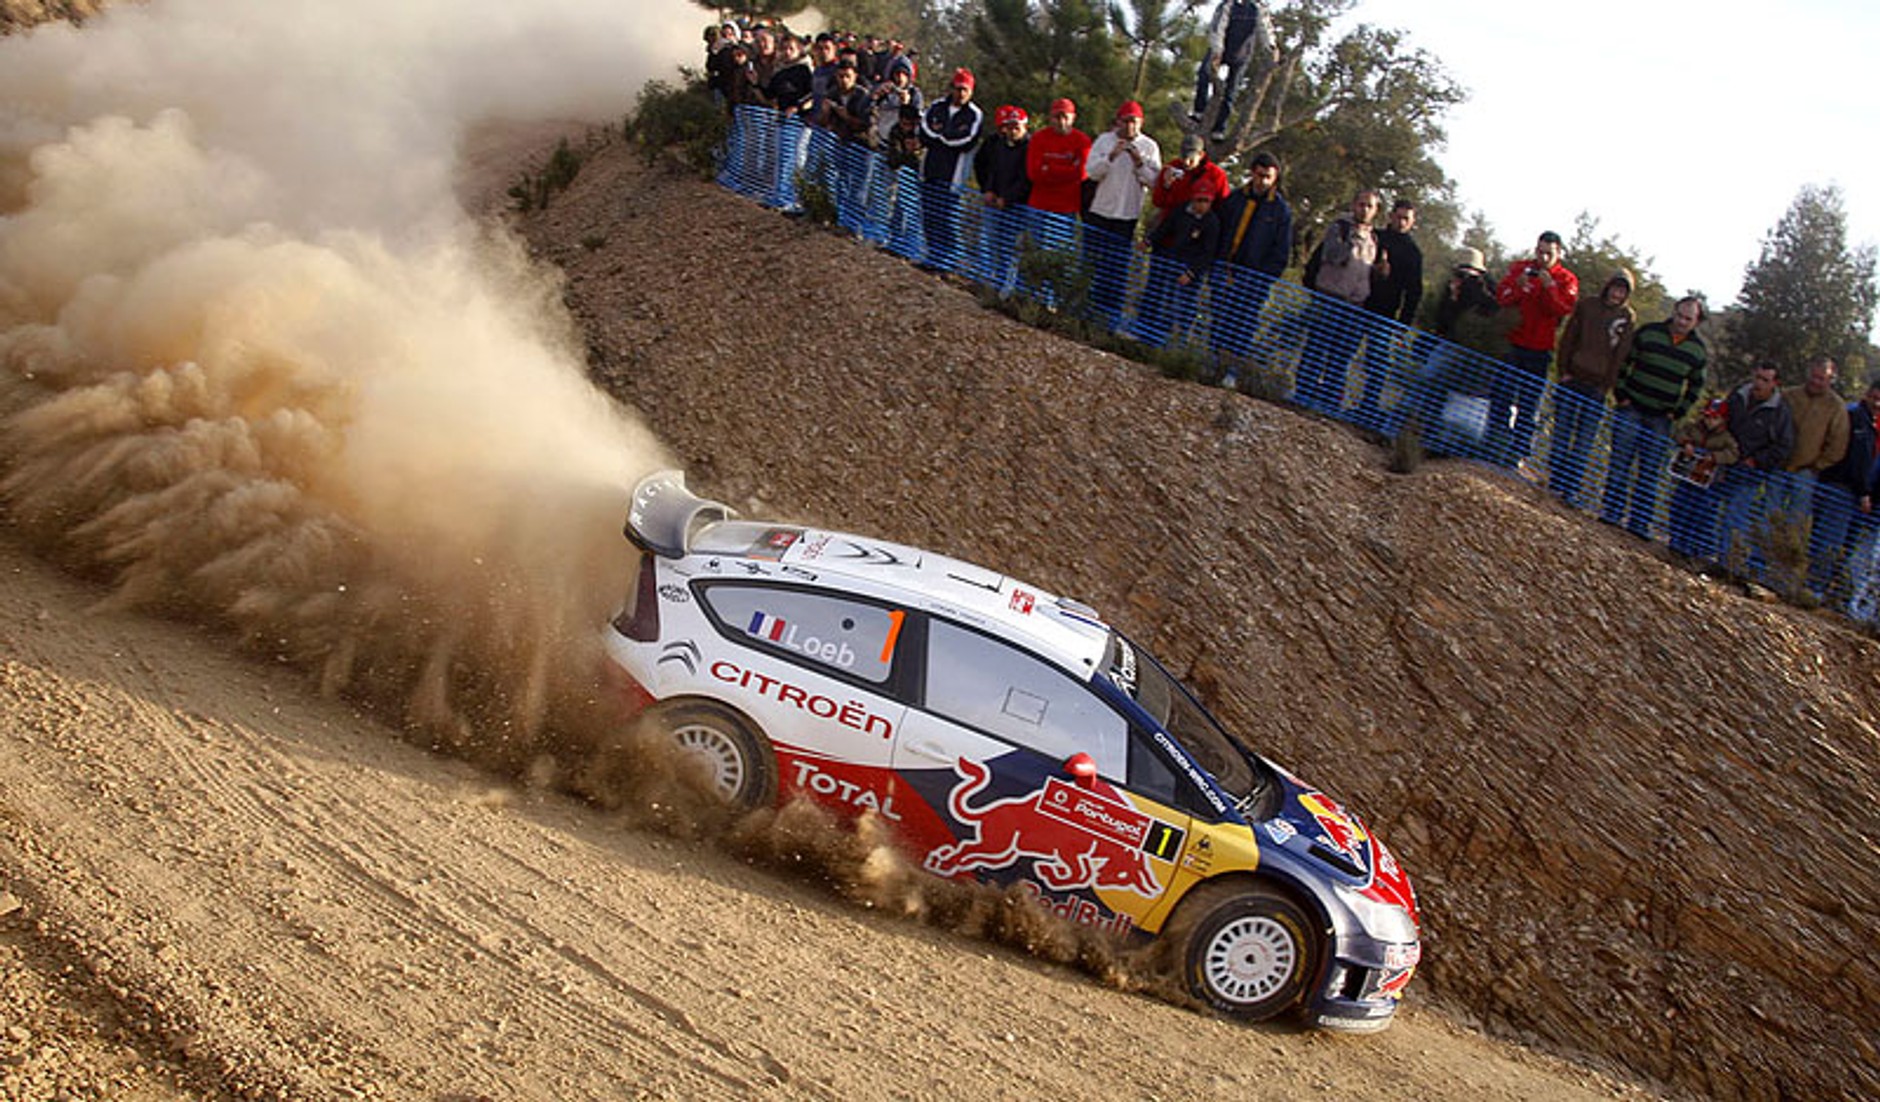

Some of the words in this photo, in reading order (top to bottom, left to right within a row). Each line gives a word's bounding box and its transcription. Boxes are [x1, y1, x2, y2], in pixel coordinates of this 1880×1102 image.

[786, 624, 855, 667] Loeb
[879, 610, 903, 663] 1
[710, 661, 892, 740] CITROËN
[1074, 802, 1141, 837] Portugal
[1156, 828, 1172, 857] 1
